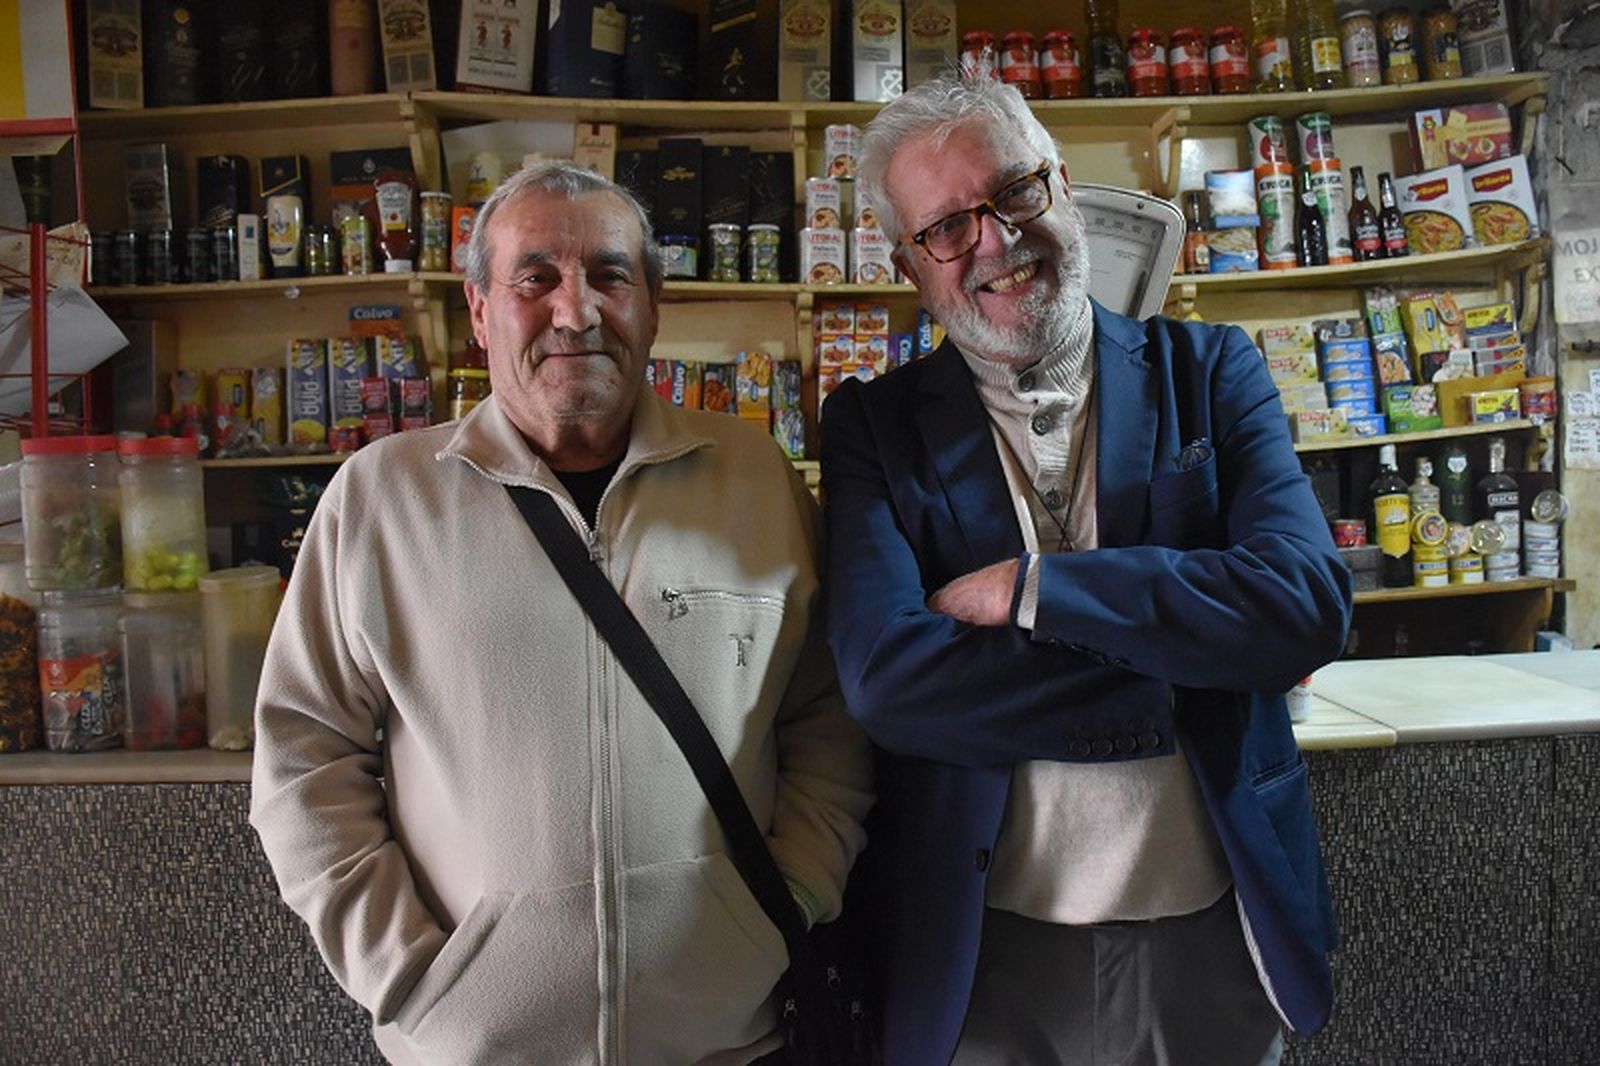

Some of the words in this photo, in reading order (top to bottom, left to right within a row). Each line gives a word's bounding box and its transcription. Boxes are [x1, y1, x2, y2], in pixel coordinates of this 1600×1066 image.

[353, 306, 394, 320] Calvo
[919, 313, 933, 350] Calvo
[671, 365, 686, 405] Calvo
